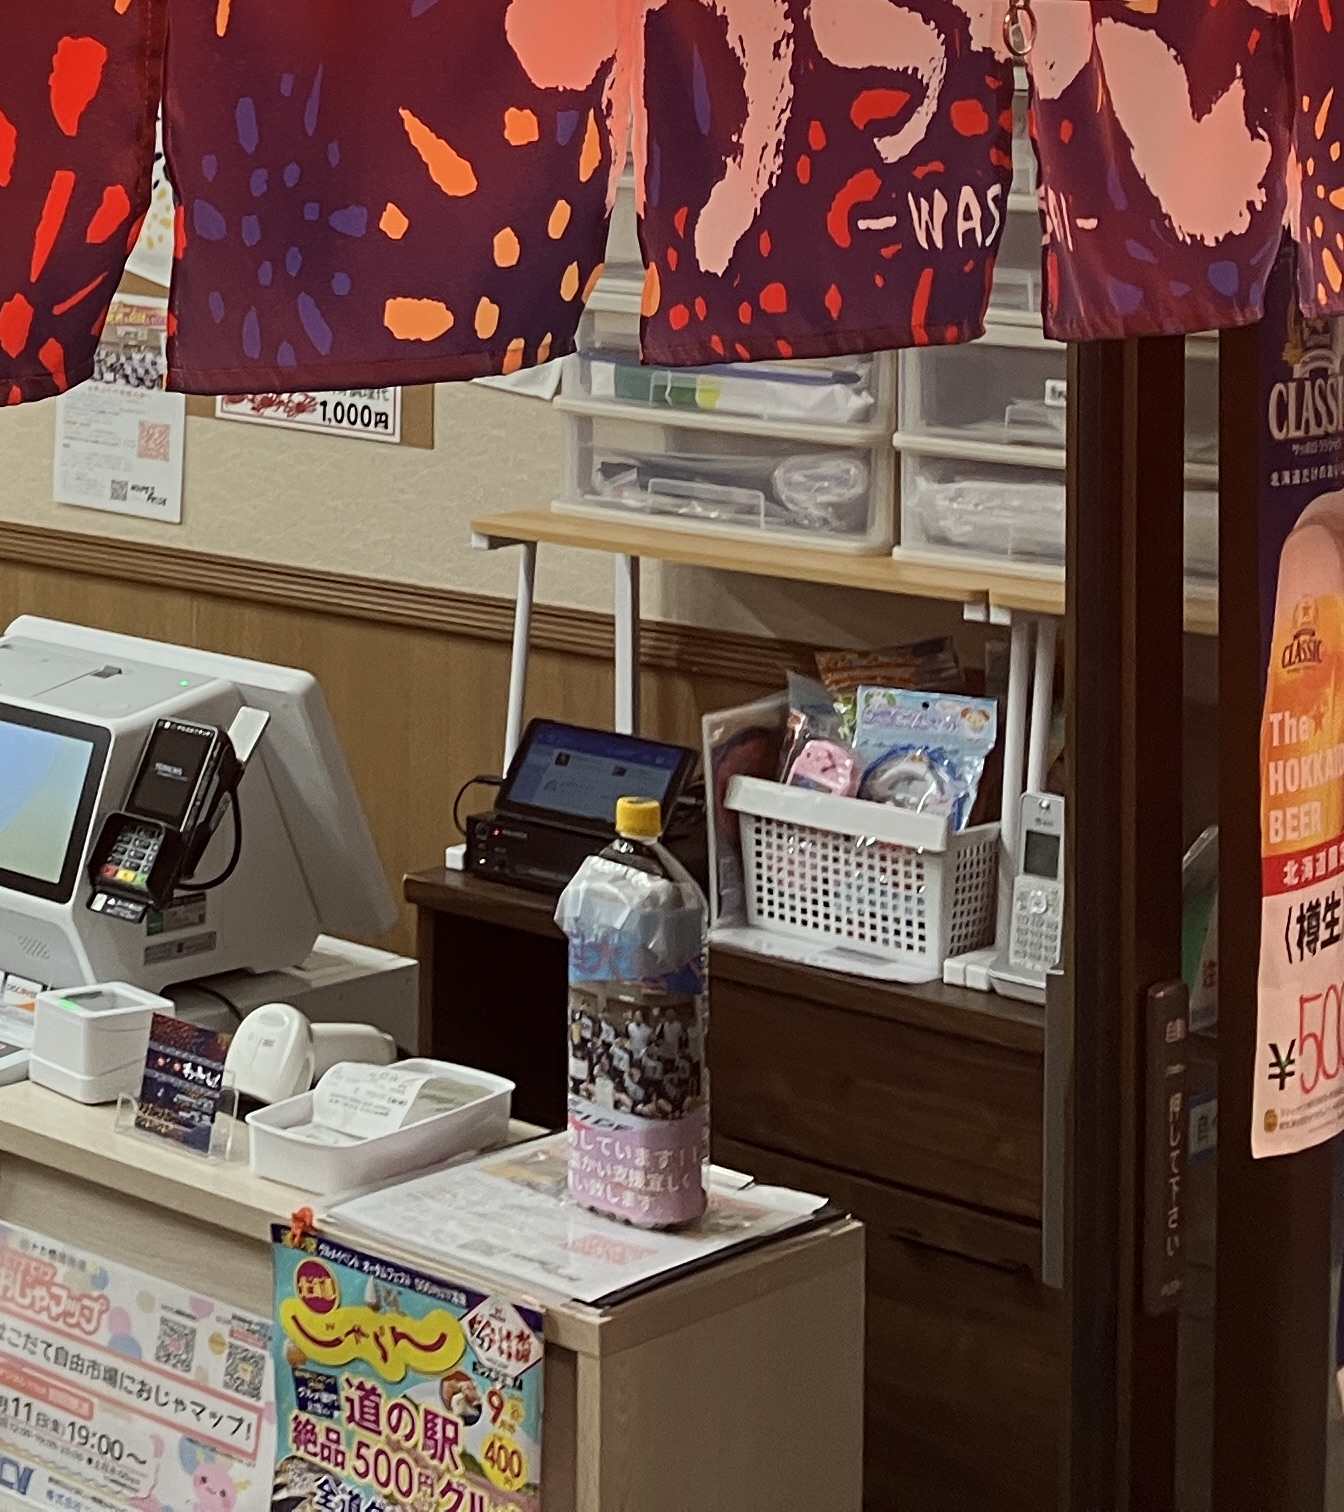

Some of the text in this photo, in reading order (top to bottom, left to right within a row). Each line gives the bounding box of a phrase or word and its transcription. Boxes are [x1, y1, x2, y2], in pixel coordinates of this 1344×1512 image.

[319, 400, 389, 430] 1,000円
[1282, 640, 1322, 670] CLASSIC
[1269, 710, 1309, 747] The
[1269, 800, 1322, 845] BEER
[291, 1313, 448, 1364] じゃらん
[344, 1376, 461, 1470] 道の駅
[483, 1439, 523, 1479] 400
